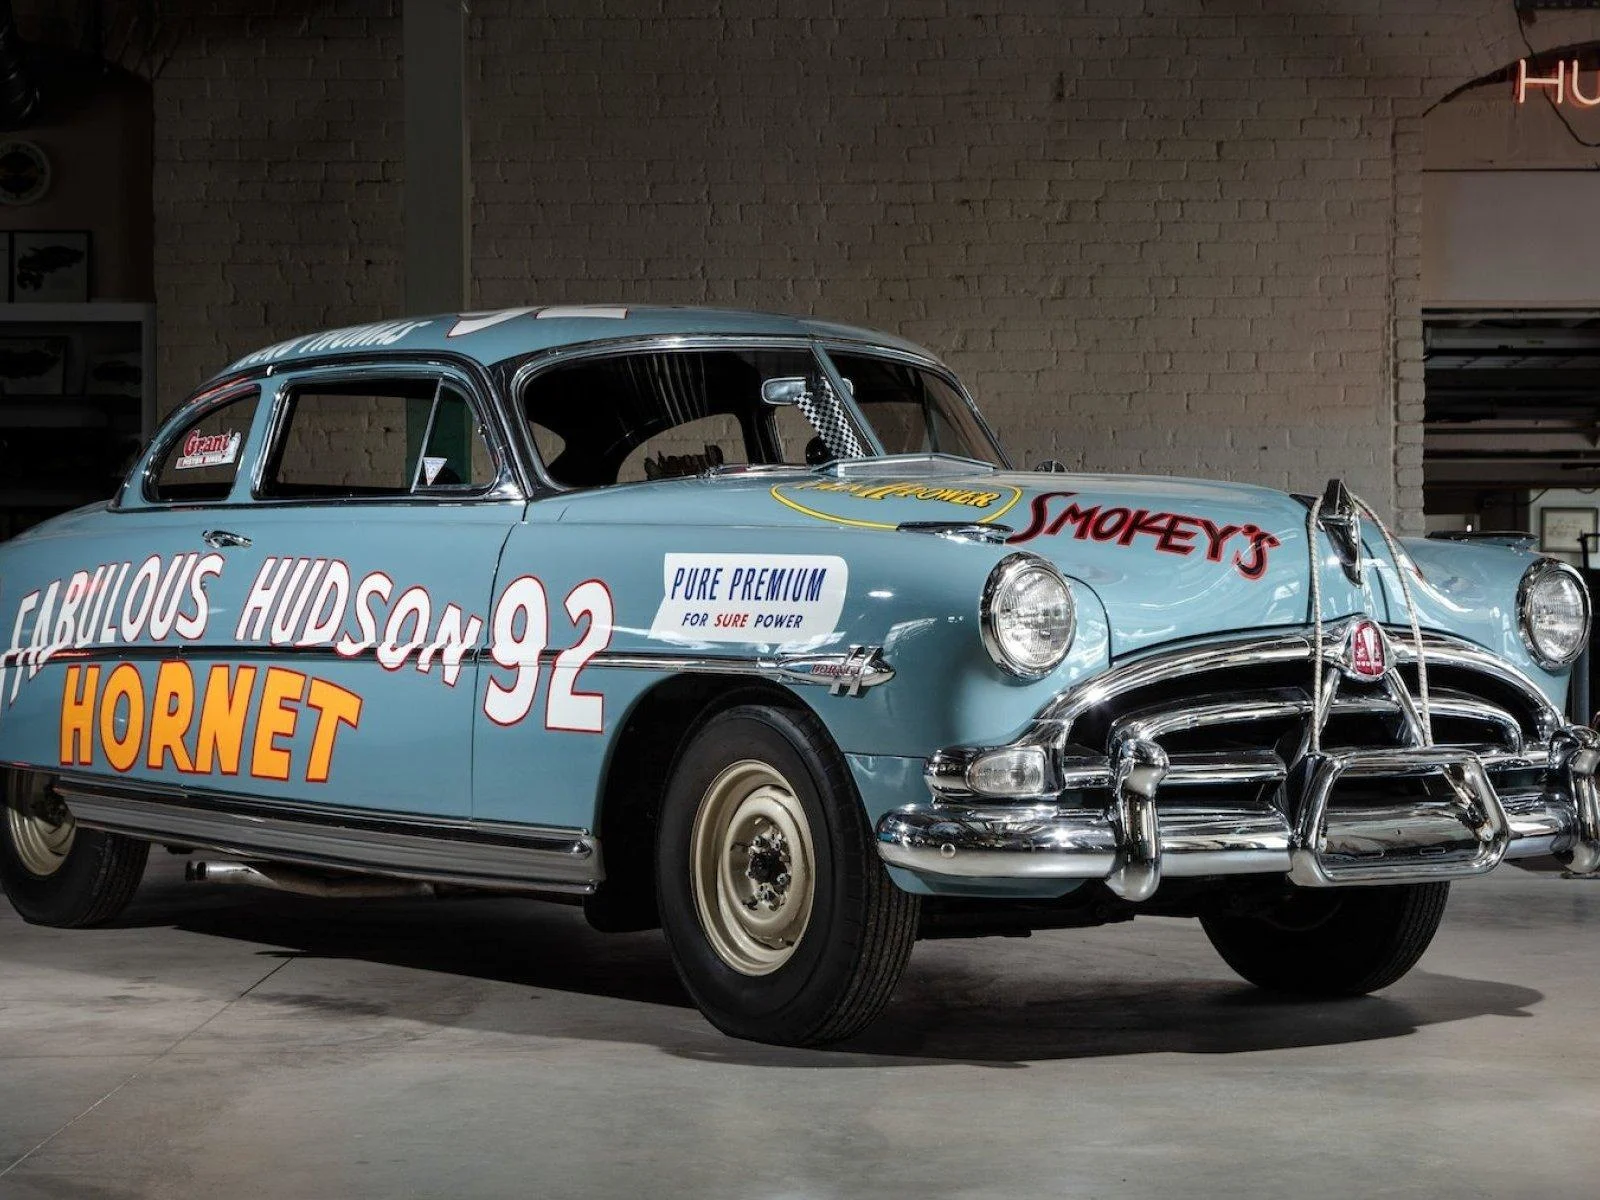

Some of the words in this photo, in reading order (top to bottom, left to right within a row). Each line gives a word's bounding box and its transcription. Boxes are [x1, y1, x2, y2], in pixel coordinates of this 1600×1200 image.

[0, 552, 225, 708] FABULOUS
[235, 556, 484, 687] HUDSON
[671, 567, 723, 600] PURE
[729, 567, 827, 602] PREMIUM
[681, 612, 709, 627] FOR
[714, 613, 749, 628] SURE
[754, 614, 804, 628] POWER
[483, 574, 614, 734] 92
[60, 659, 363, 784] HORNET
